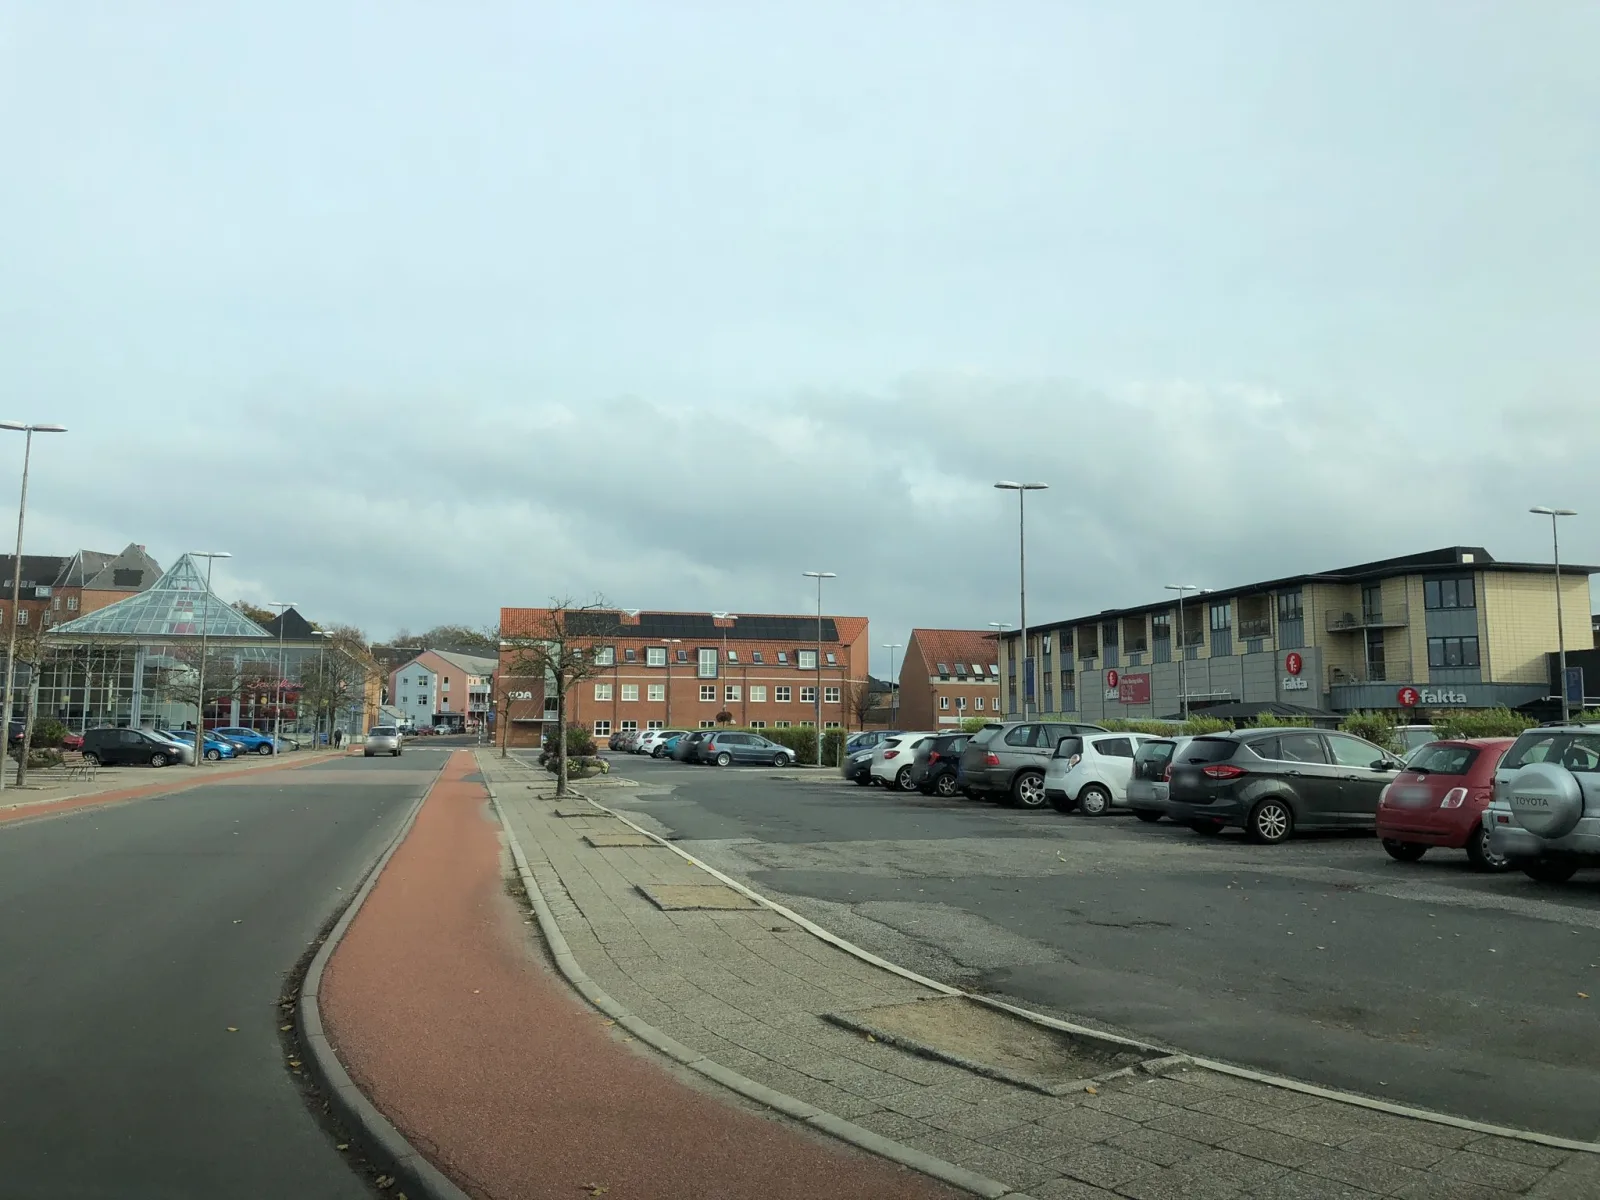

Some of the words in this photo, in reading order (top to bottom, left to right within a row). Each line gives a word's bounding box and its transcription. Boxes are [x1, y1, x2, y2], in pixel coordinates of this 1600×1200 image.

[1282, 677, 1308, 690] fakta
[1420, 689, 1467, 703] fakta
[1515, 796, 1549, 807] TOYOTA
